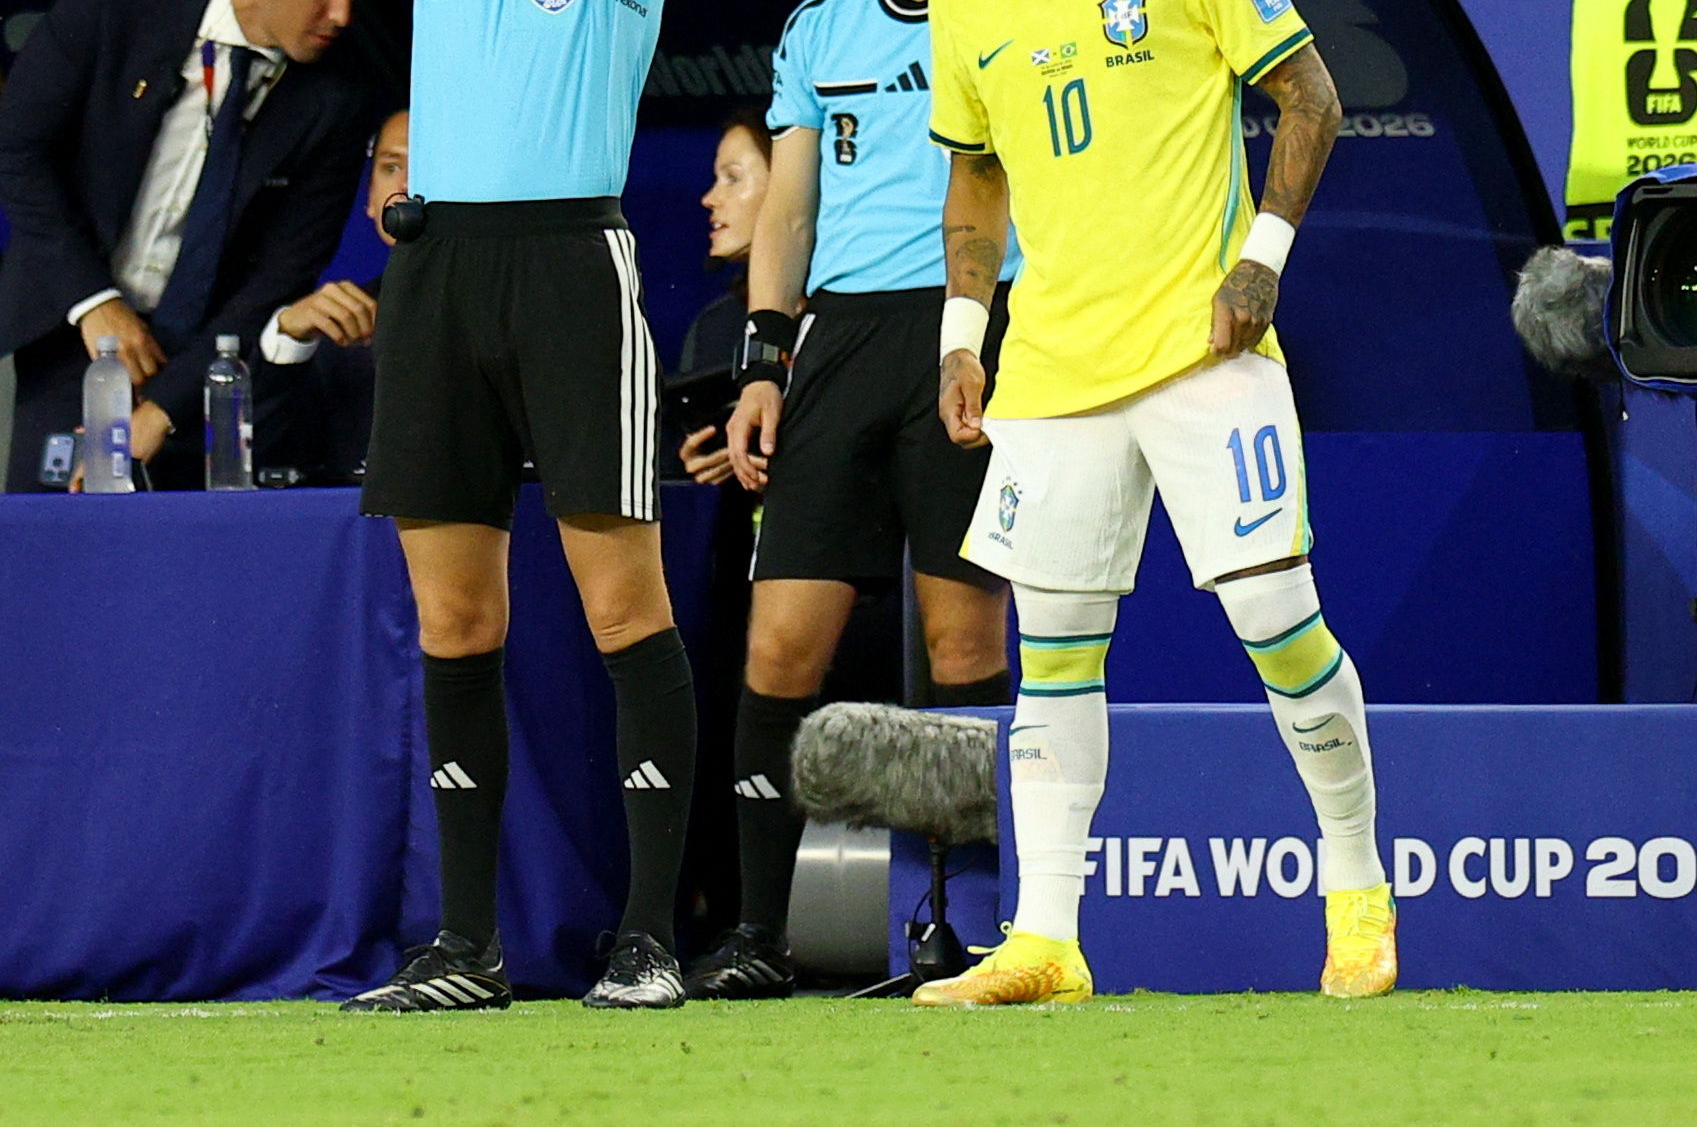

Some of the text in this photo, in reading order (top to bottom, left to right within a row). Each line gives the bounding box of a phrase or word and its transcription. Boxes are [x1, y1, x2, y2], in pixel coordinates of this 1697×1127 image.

[1105, 50, 1155, 68] BRASIL
[1646, 93, 1682, 115] FIFA
[1042, 77, 1093, 158] 10
[1338, 114, 1435, 137] 2026
[1626, 135, 1697, 149] WORLD CUP
[1225, 424, 1287, 503] 10
[988, 532, 1014, 550] BRASIL
[1208, 836, 1437, 898] WOD
[1448, 836, 1574, 898] CUP
[1585, 836, 1697, 898] 20
